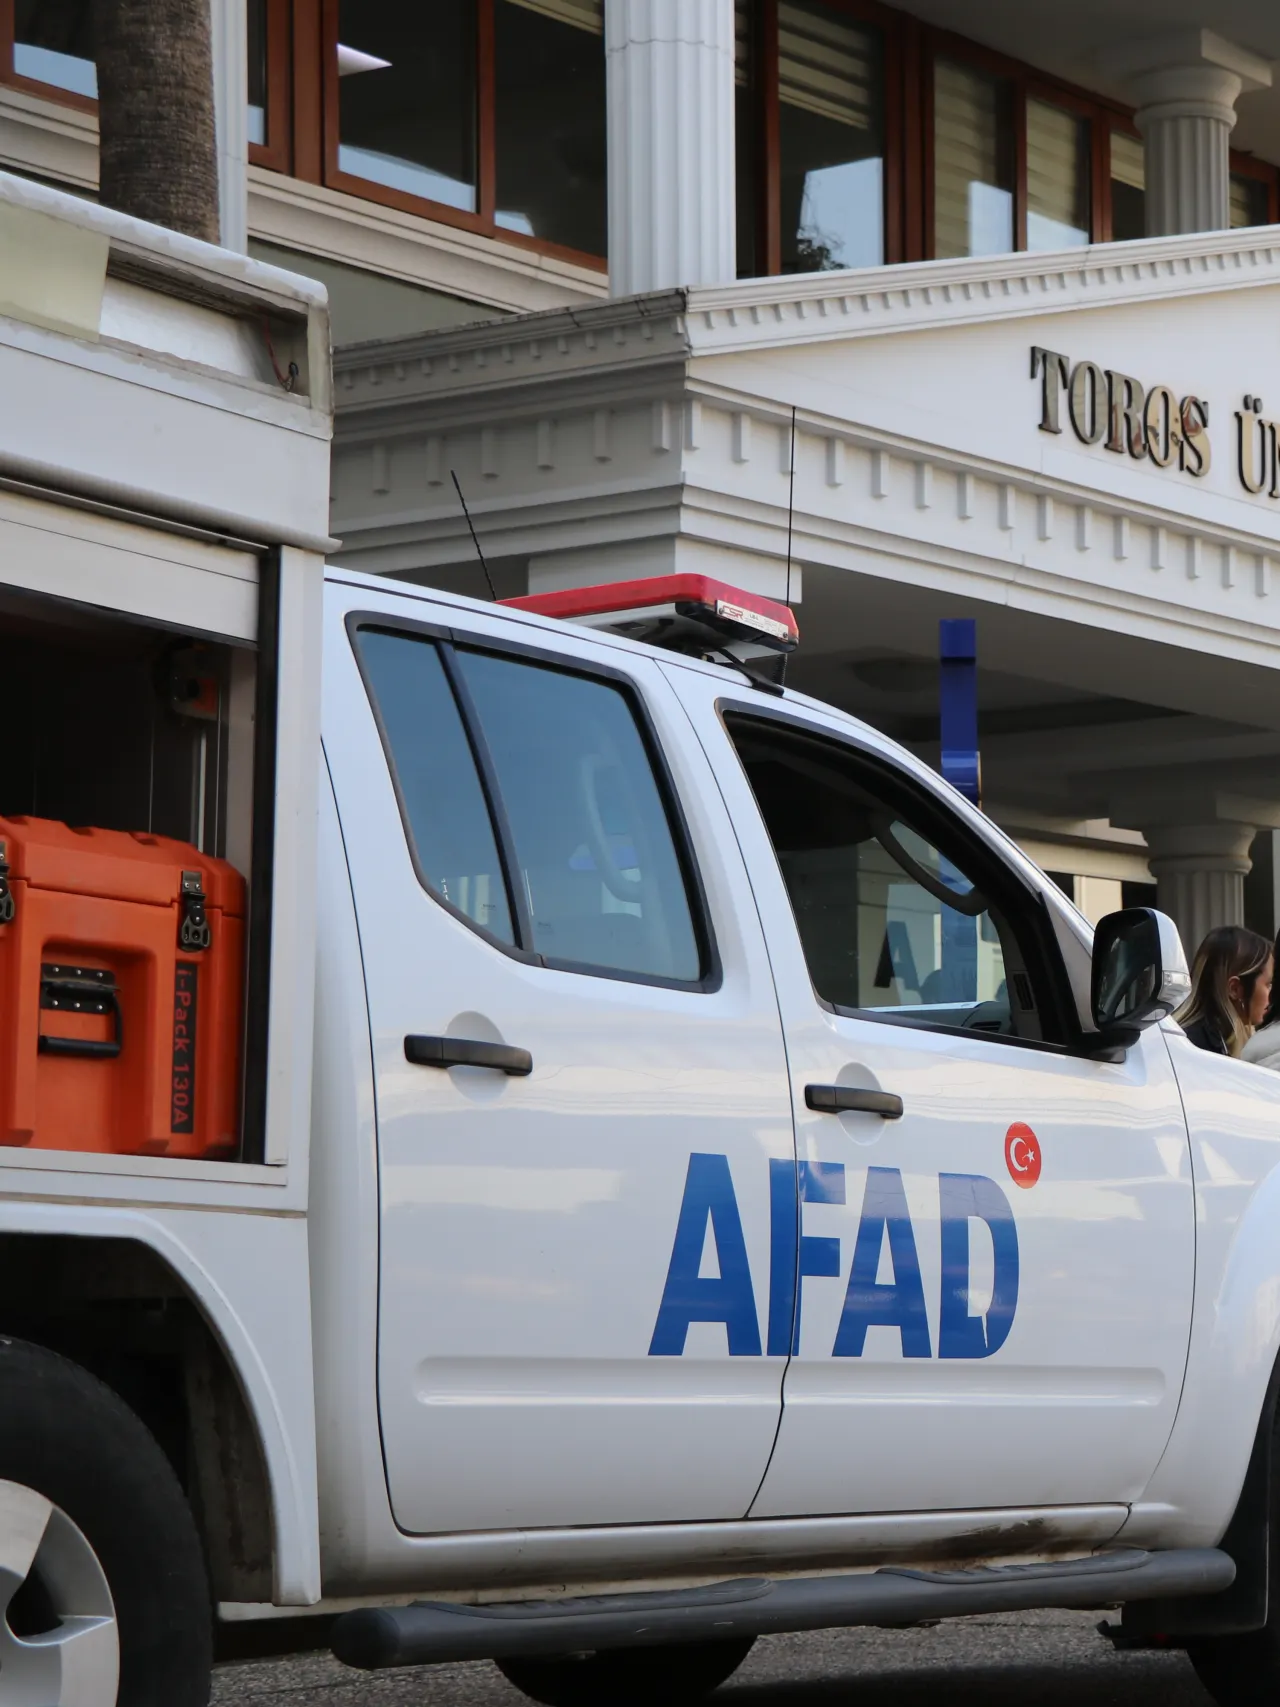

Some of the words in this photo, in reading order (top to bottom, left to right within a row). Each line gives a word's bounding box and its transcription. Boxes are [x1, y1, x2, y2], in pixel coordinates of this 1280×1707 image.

[1030, 346, 1211, 477] TOROS
[173, 1063, 190, 1125] 130A
[648, 1152, 1019, 1358] AFAD
